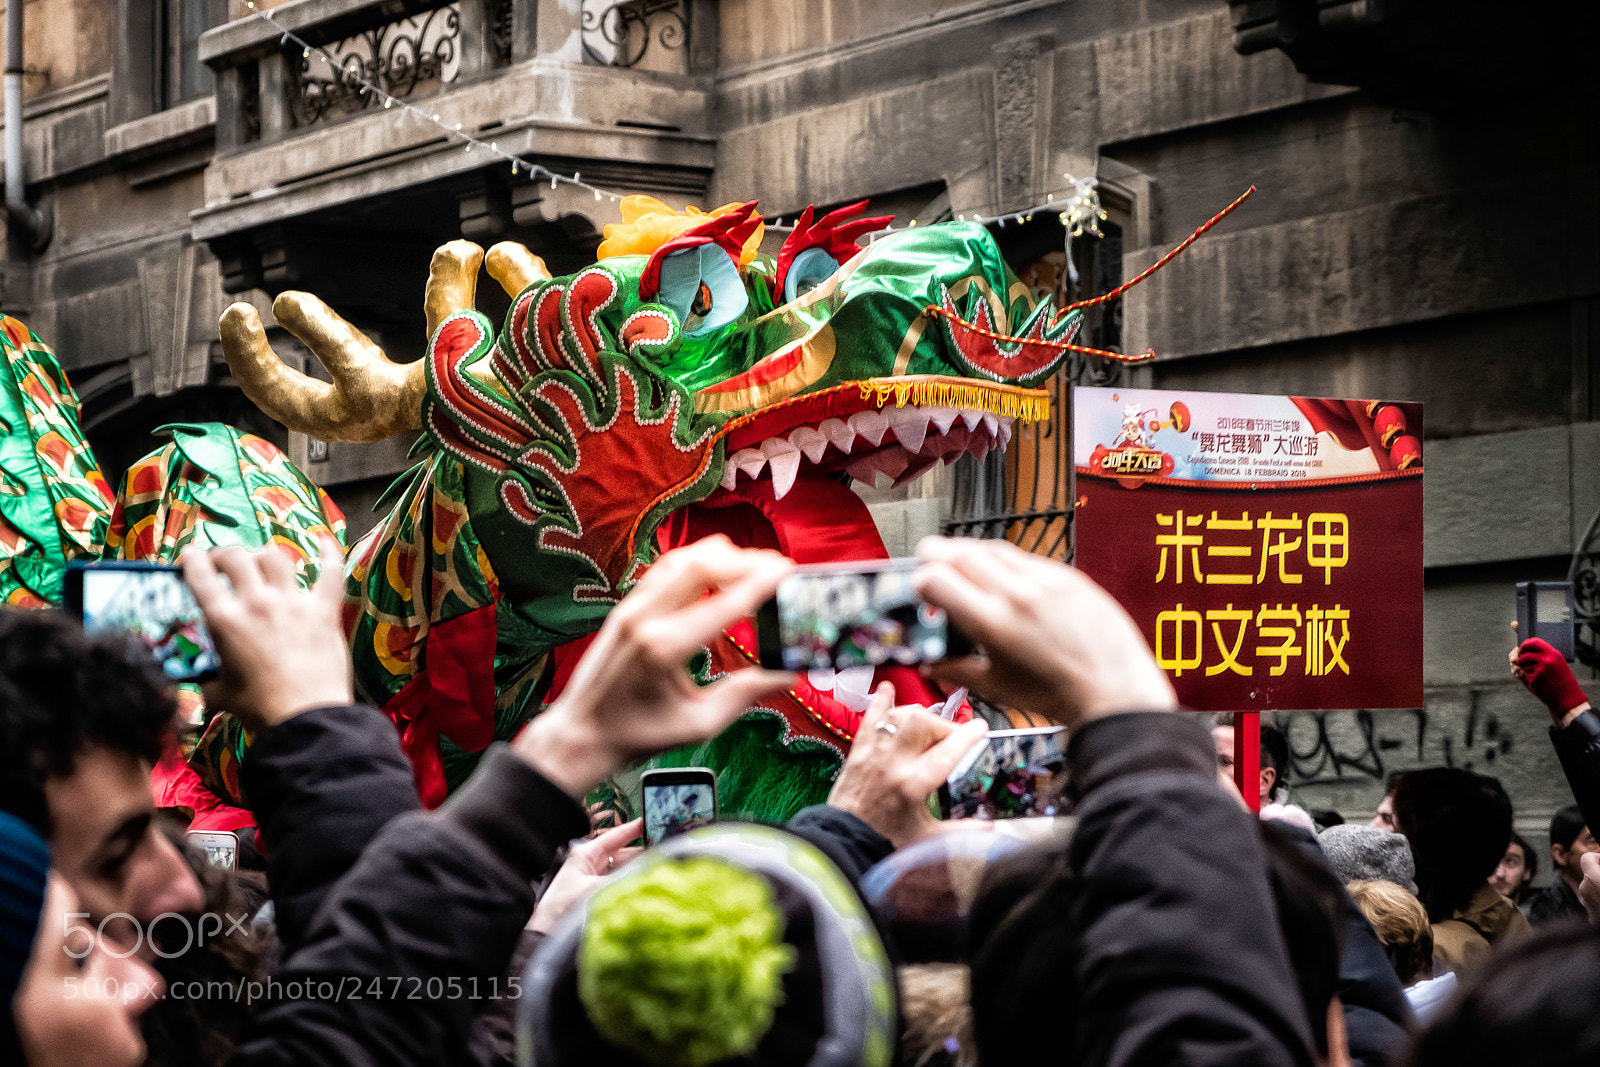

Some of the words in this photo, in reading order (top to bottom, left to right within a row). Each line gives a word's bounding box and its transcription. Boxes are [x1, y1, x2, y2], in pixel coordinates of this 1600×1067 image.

[1204, 467, 1241, 476] DOMENICA
[1244, 468, 1252, 476] 18
[1254, 468, 1289, 477] FEBBRAIO
[1290, 469, 1307, 477] 2018
[1155, 509, 1349, 585] 米兰龙甲
[1155, 603, 1350, 678] 中文学校
